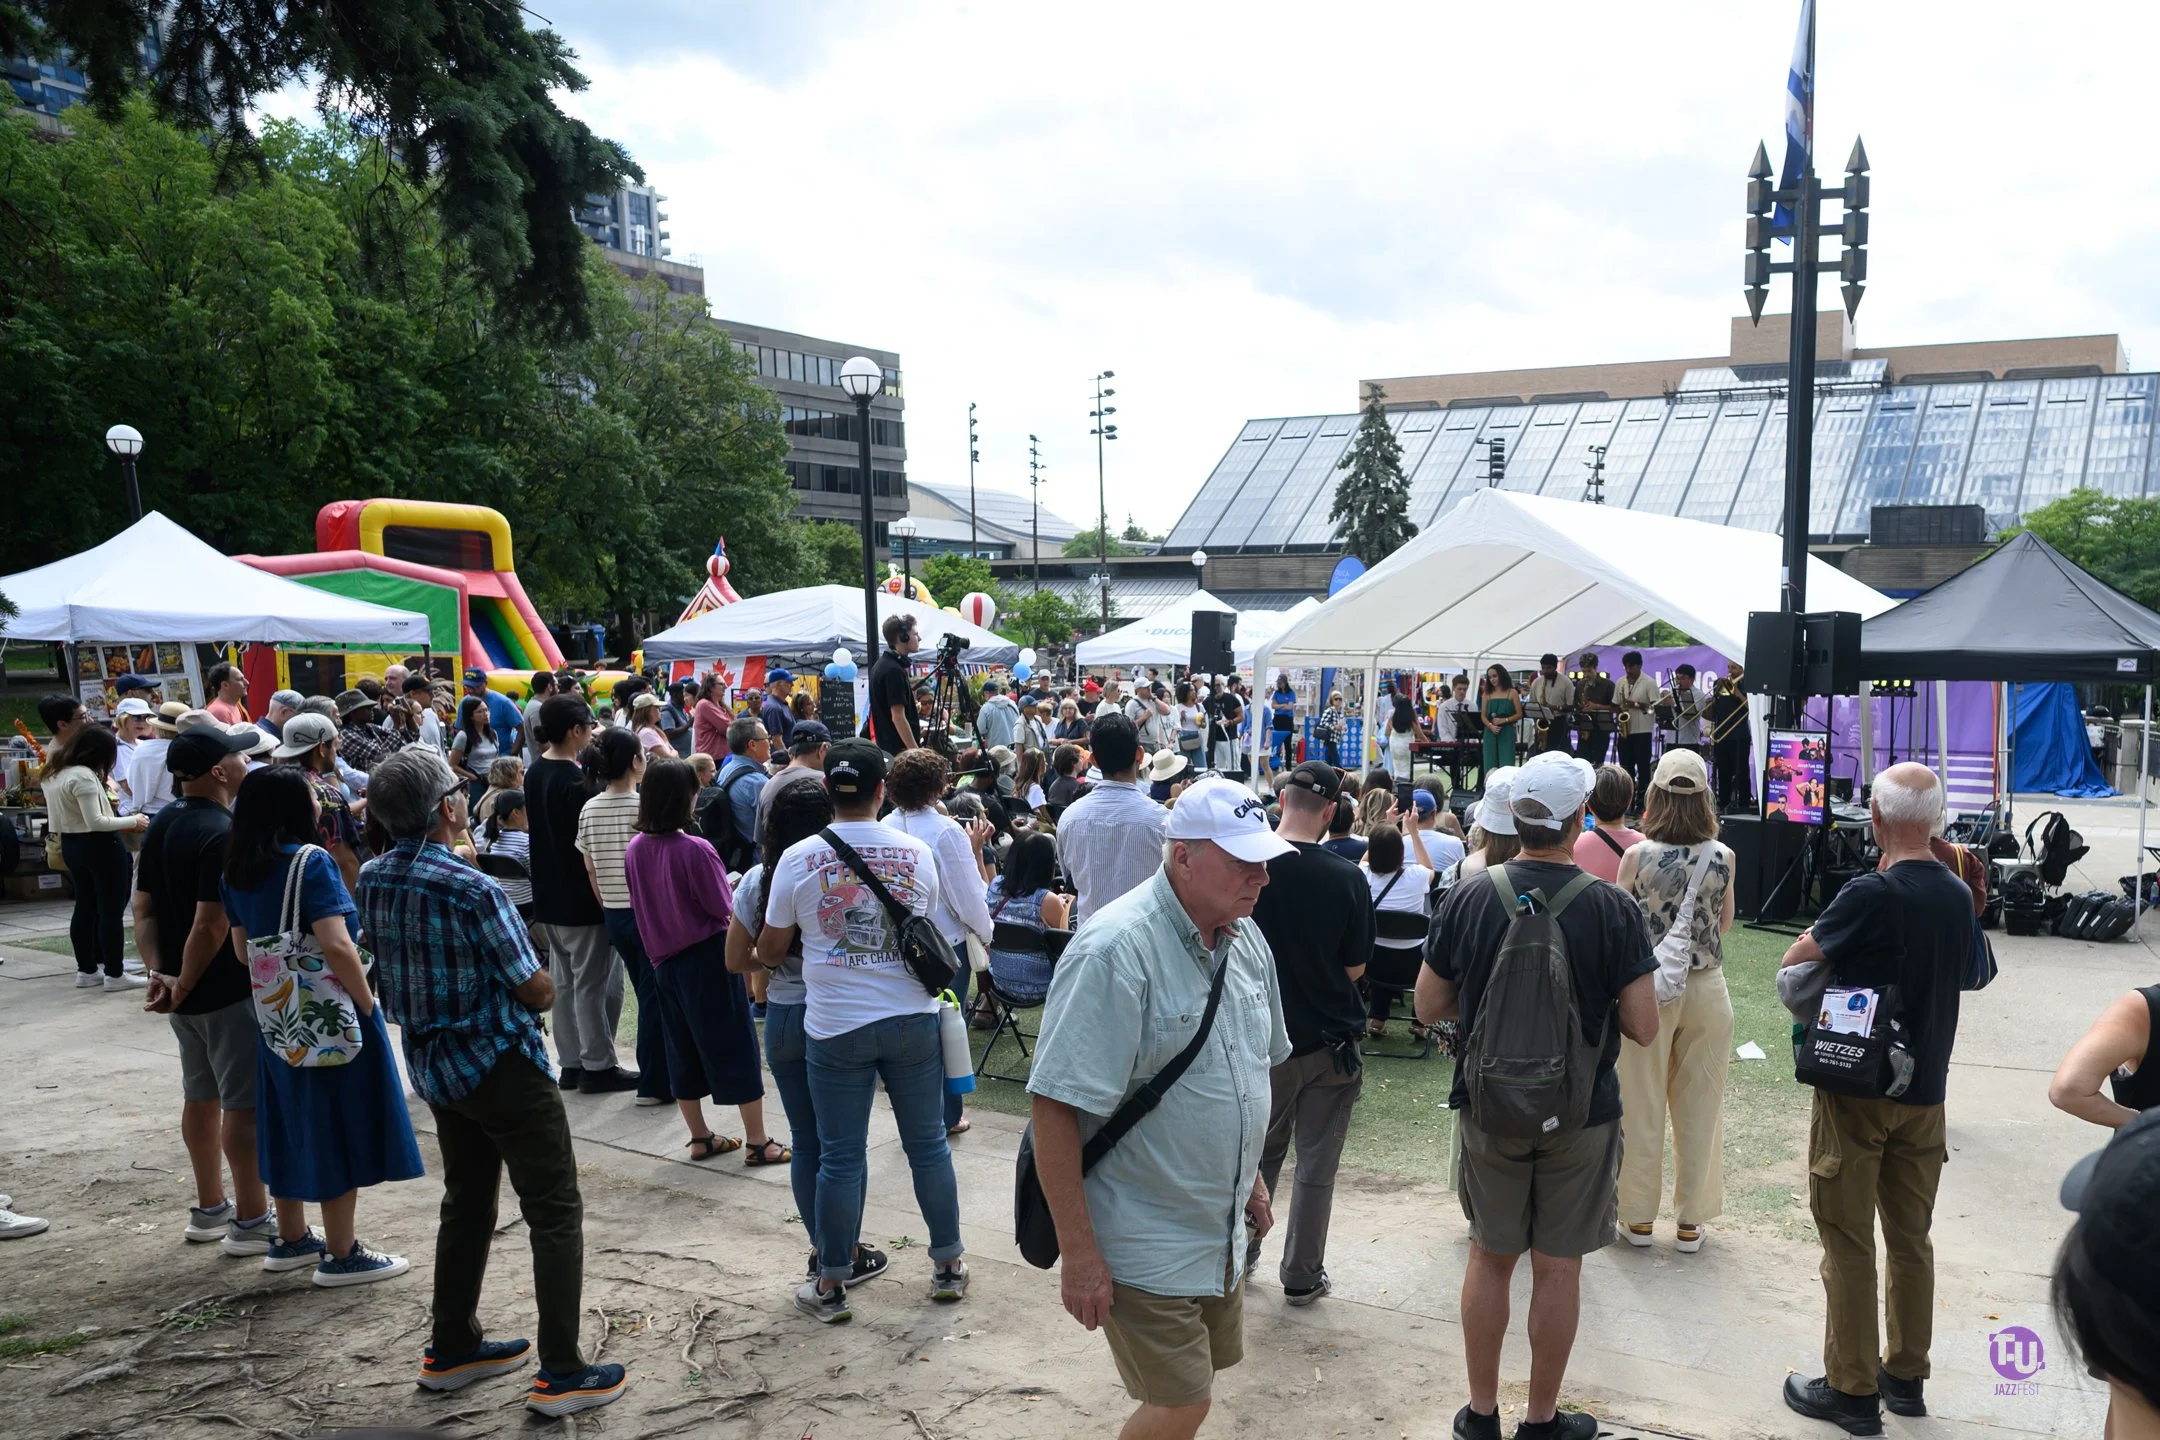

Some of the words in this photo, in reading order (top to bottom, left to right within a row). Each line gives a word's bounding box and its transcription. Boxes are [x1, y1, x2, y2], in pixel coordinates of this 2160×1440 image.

[881, 847, 920, 864] CITY
[819, 860, 915, 893] CHEFS
[849, 954, 868, 967] AFC
[870, 951, 905, 964] CHAM
[1814, 1039, 1866, 1058] WIETZES
